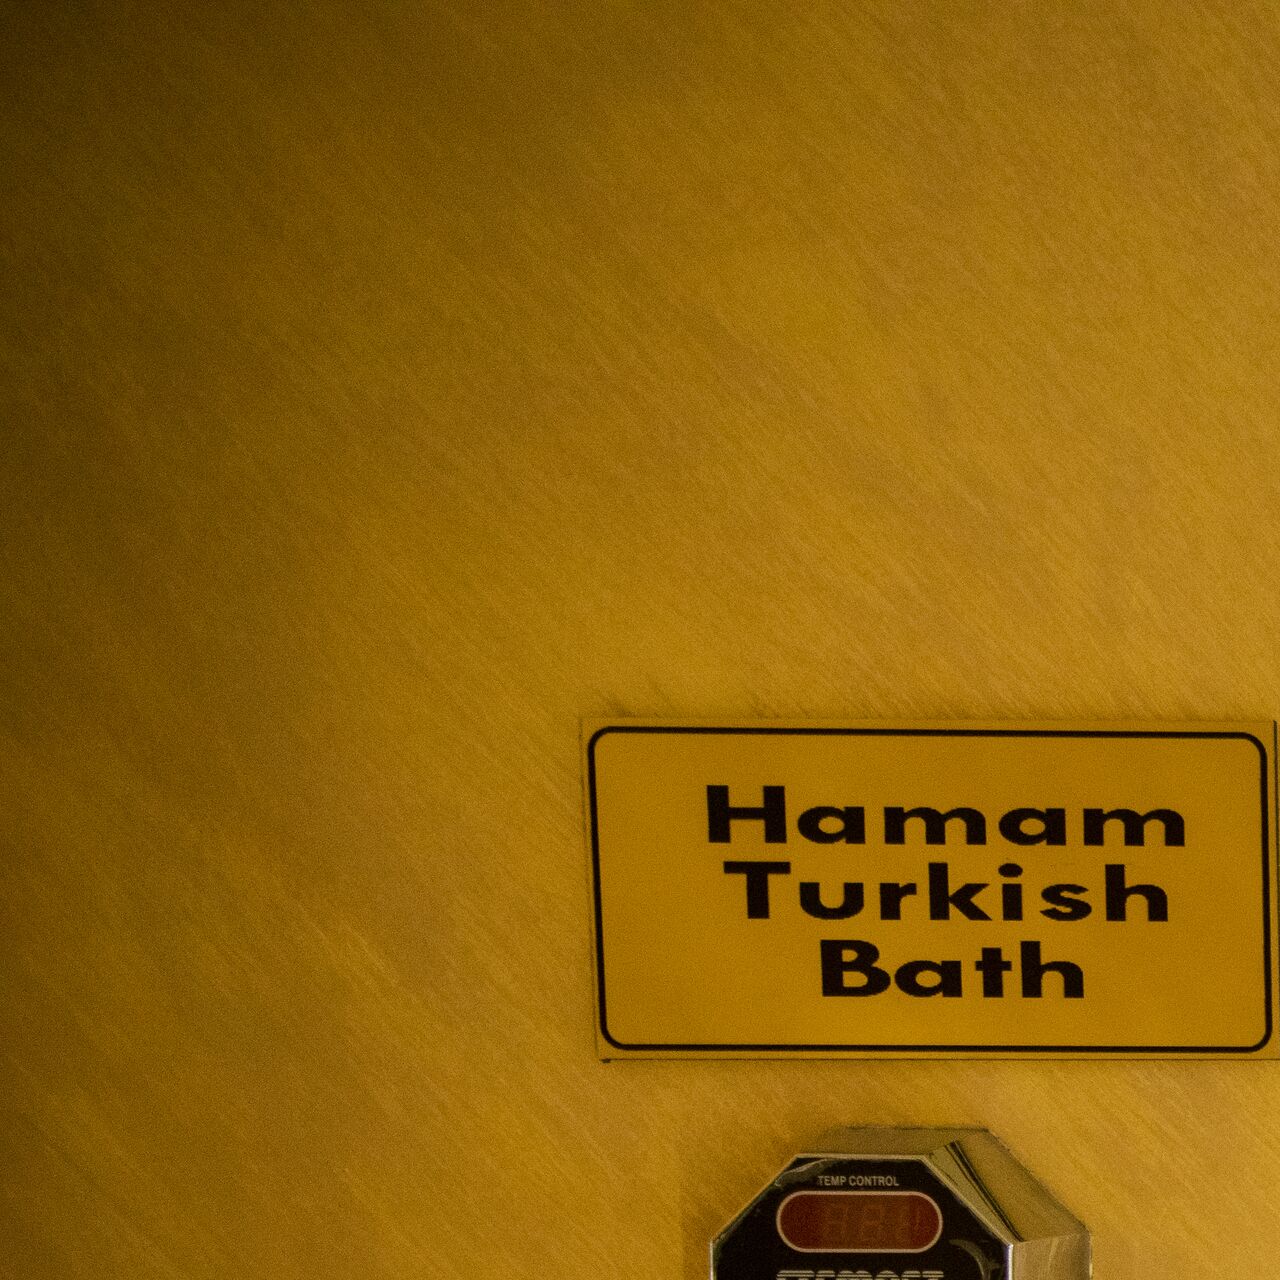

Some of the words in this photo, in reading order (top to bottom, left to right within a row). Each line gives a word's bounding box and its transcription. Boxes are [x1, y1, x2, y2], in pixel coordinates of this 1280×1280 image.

[707, 785, 1185, 847] Hamam
[723, 861, 1168, 922] Turkish
[820, 939, 1085, 998] Bath
[818, 1175, 847, 1187] TEMP
[848, 1175, 900, 1187] CONTROL
